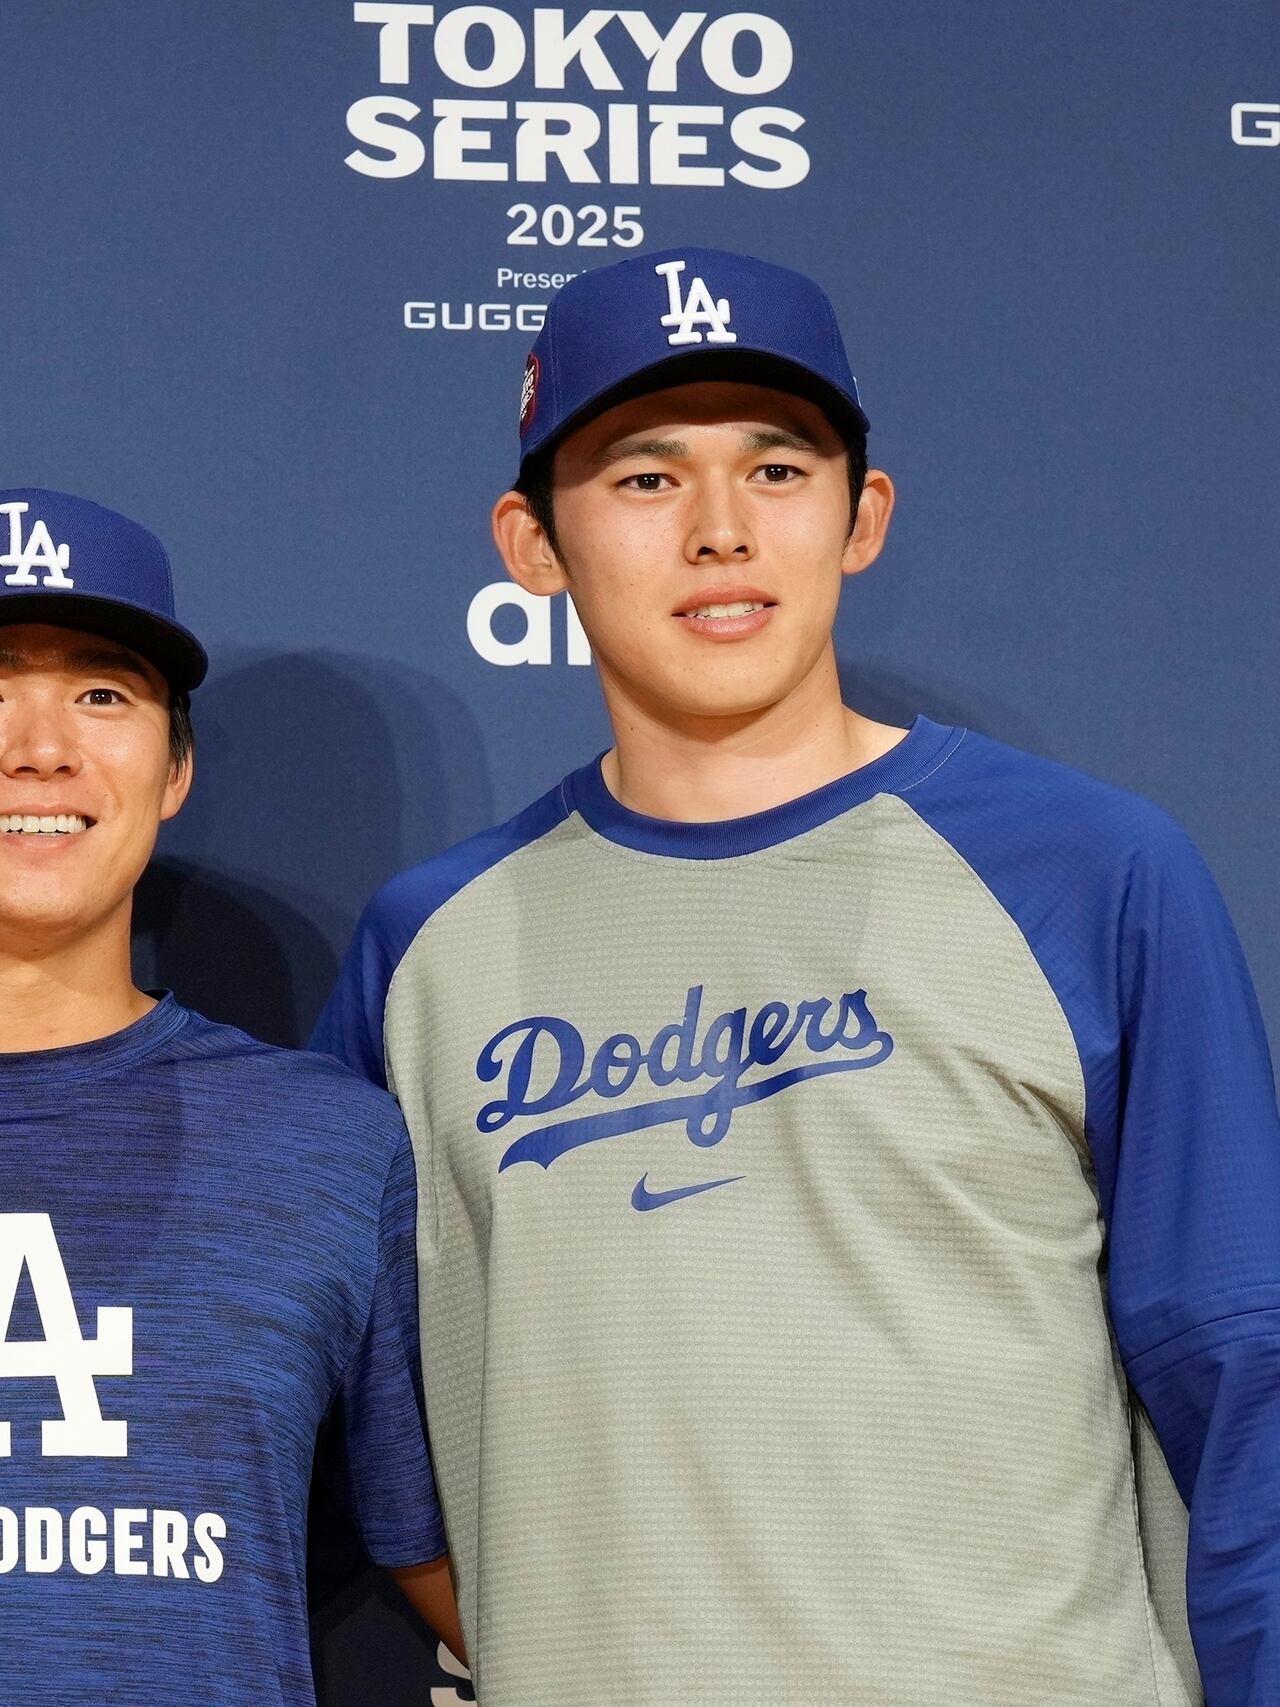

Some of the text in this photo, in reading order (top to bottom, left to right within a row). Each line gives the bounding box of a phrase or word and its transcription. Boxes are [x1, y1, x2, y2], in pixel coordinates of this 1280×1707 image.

[354, 2, 793, 95] TOKYO
[344, 96, 811, 189] SERIES
[506, 204, 644, 248] 2025
[497, 267, 587, 289] Prese
[656, 260, 737, 345] LA
[0, 502, 74, 590] LA
[477, 985, 893, 1168] Dodgers
